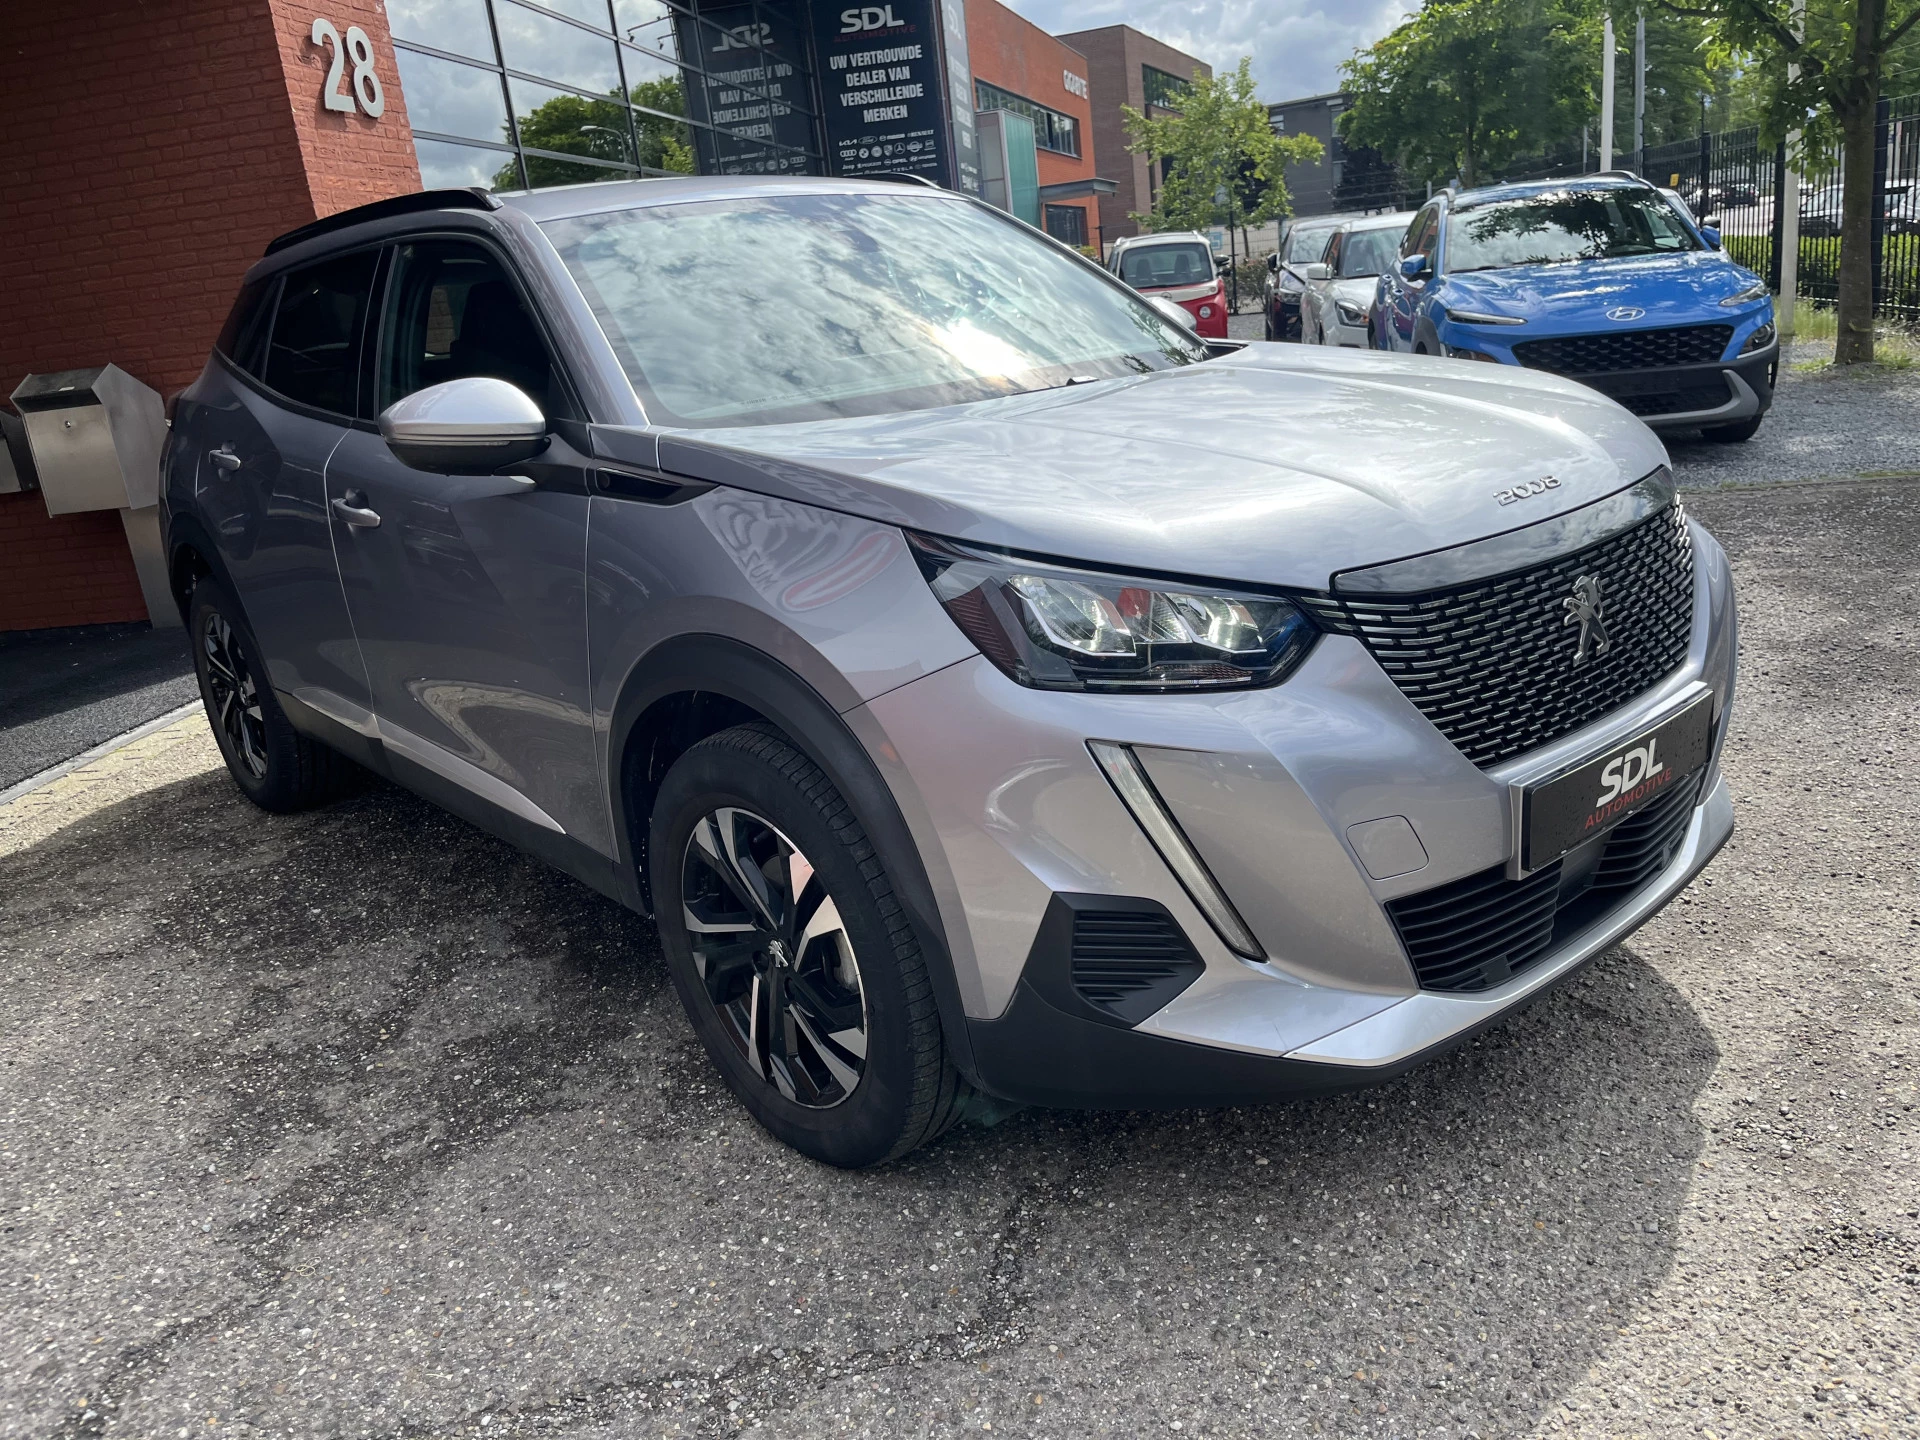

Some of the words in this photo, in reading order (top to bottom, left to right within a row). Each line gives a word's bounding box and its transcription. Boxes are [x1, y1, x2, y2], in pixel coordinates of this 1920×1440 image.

[840, 4, 905, 34] SDL
[311, 17, 385, 118] 28
[829, 55, 848, 70] UW
[849, 44, 923, 68] VERTROUWDE
[845, 69, 887, 88] DEALER
[887, 65, 911, 82] VAN
[840, 83, 924, 107] VERSCHILLENDE
[863, 104, 908, 124] MERKEN
[1493, 475, 1561, 506] 2008
[1596, 737, 1663, 808] SDL
[1585, 767, 1673, 830] AUTOMOTIVE
